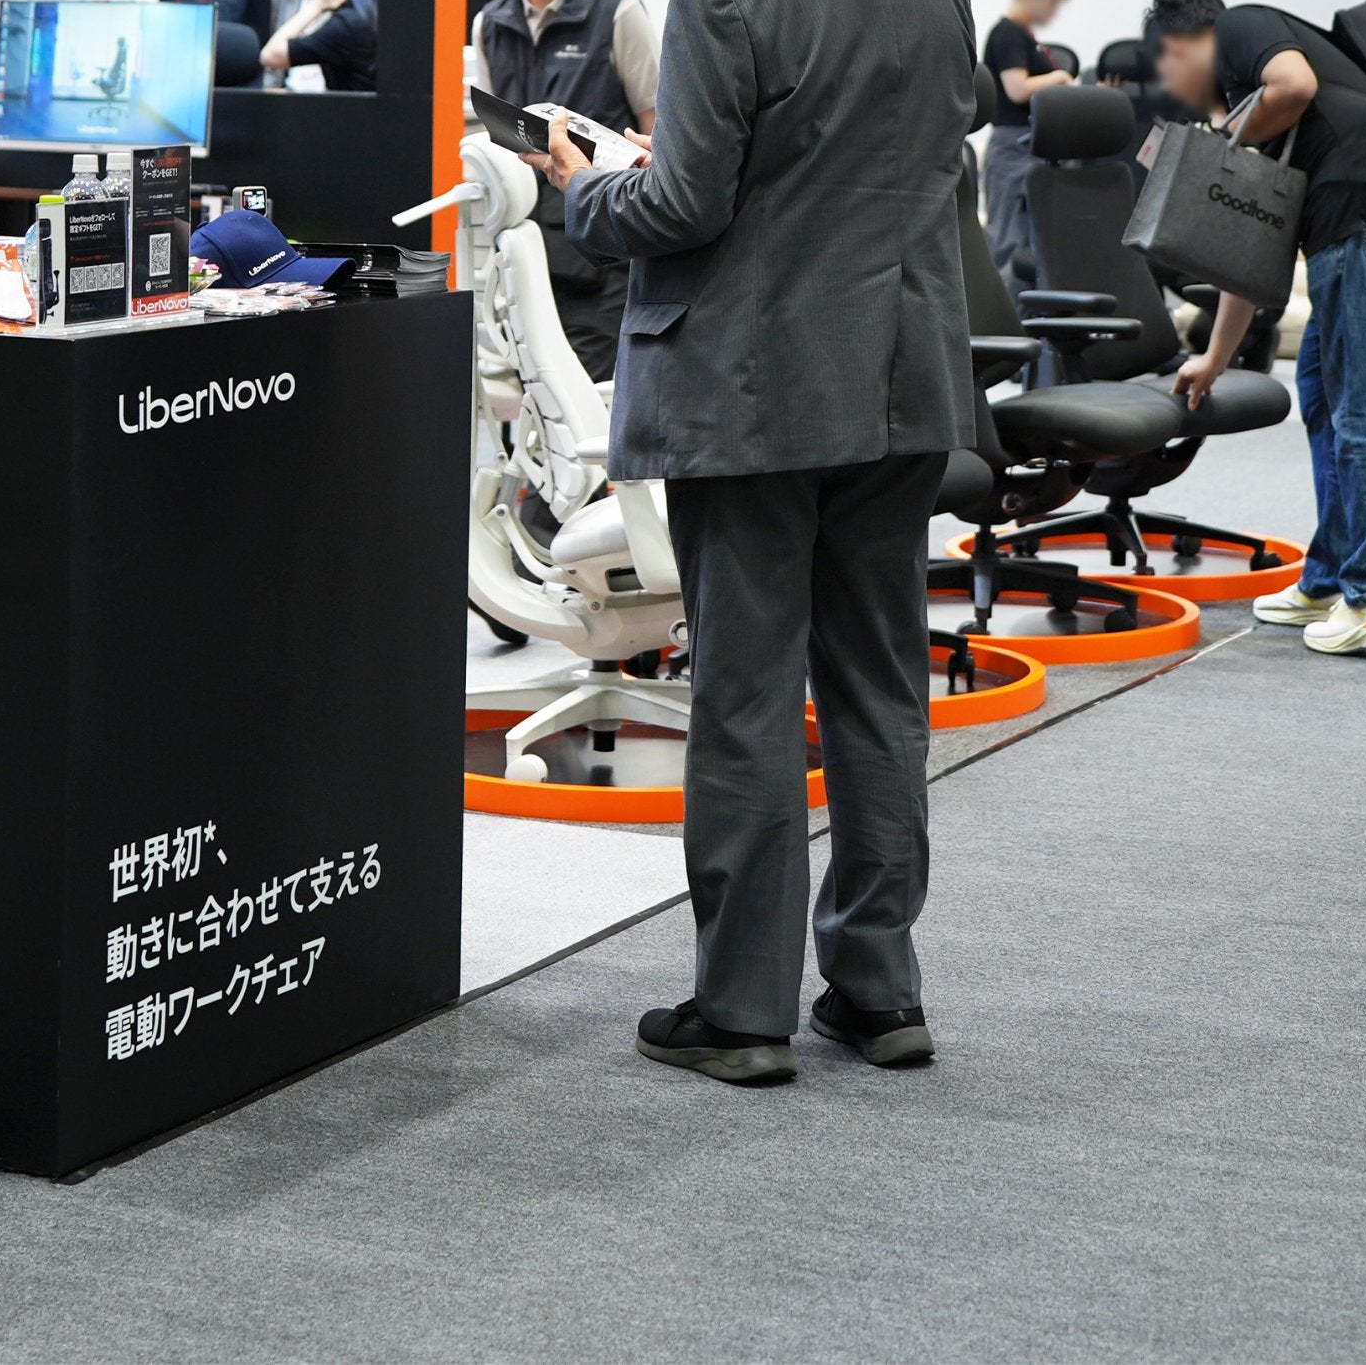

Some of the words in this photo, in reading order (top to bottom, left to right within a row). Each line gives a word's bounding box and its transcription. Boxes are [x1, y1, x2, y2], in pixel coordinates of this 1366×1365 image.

[1208, 182, 1285, 228] Goodtone
[248, 250, 286, 276] LiberNovo
[131, 298, 188, 315] LiberNovo
[119, 372, 296, 434] LiberNovo
[106, 842, 382, 983] 動きに合わせて支える
[105, 936, 326, 1061] 電動ワークチェア
